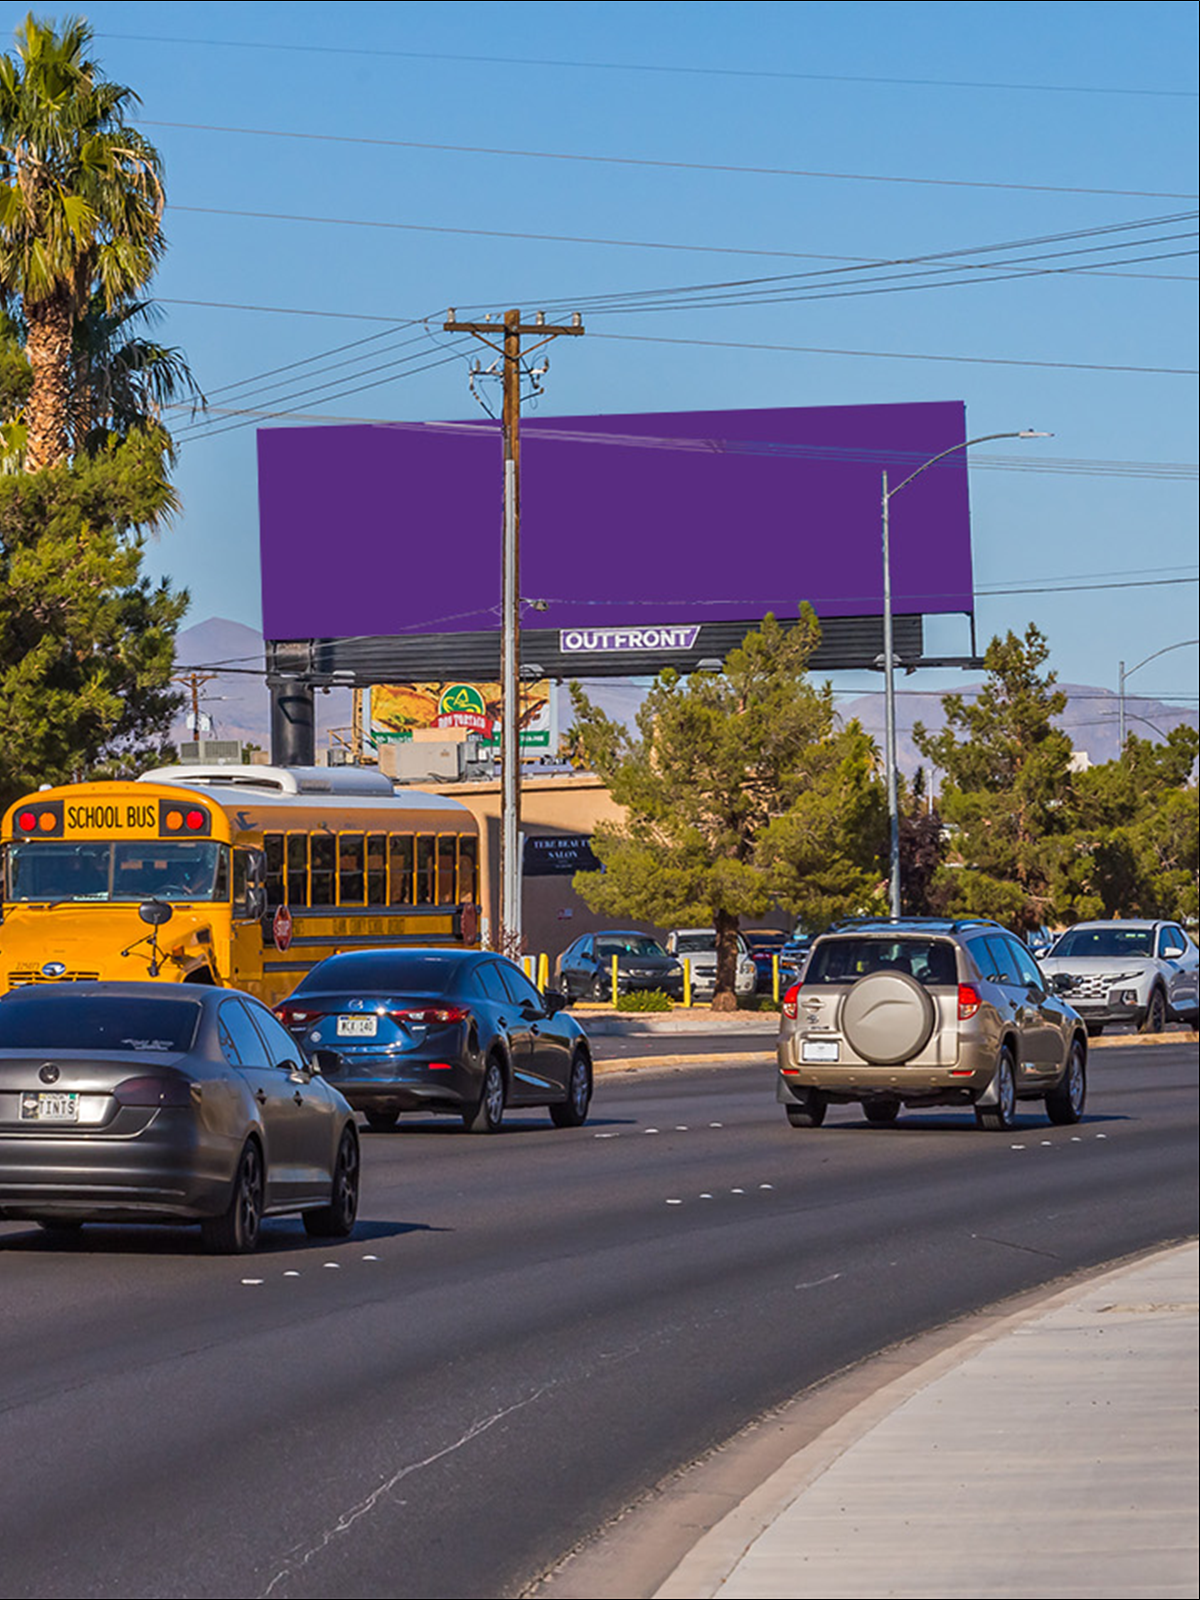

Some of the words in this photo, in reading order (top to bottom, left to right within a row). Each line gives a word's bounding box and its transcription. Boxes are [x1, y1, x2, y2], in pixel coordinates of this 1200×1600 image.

[565, 629, 691, 650] OUTFRONT
[67, 805, 123, 829] SCHOOL
[126, 805, 156, 828] BUS
[39, 1100, 75, 1115] TINTS
